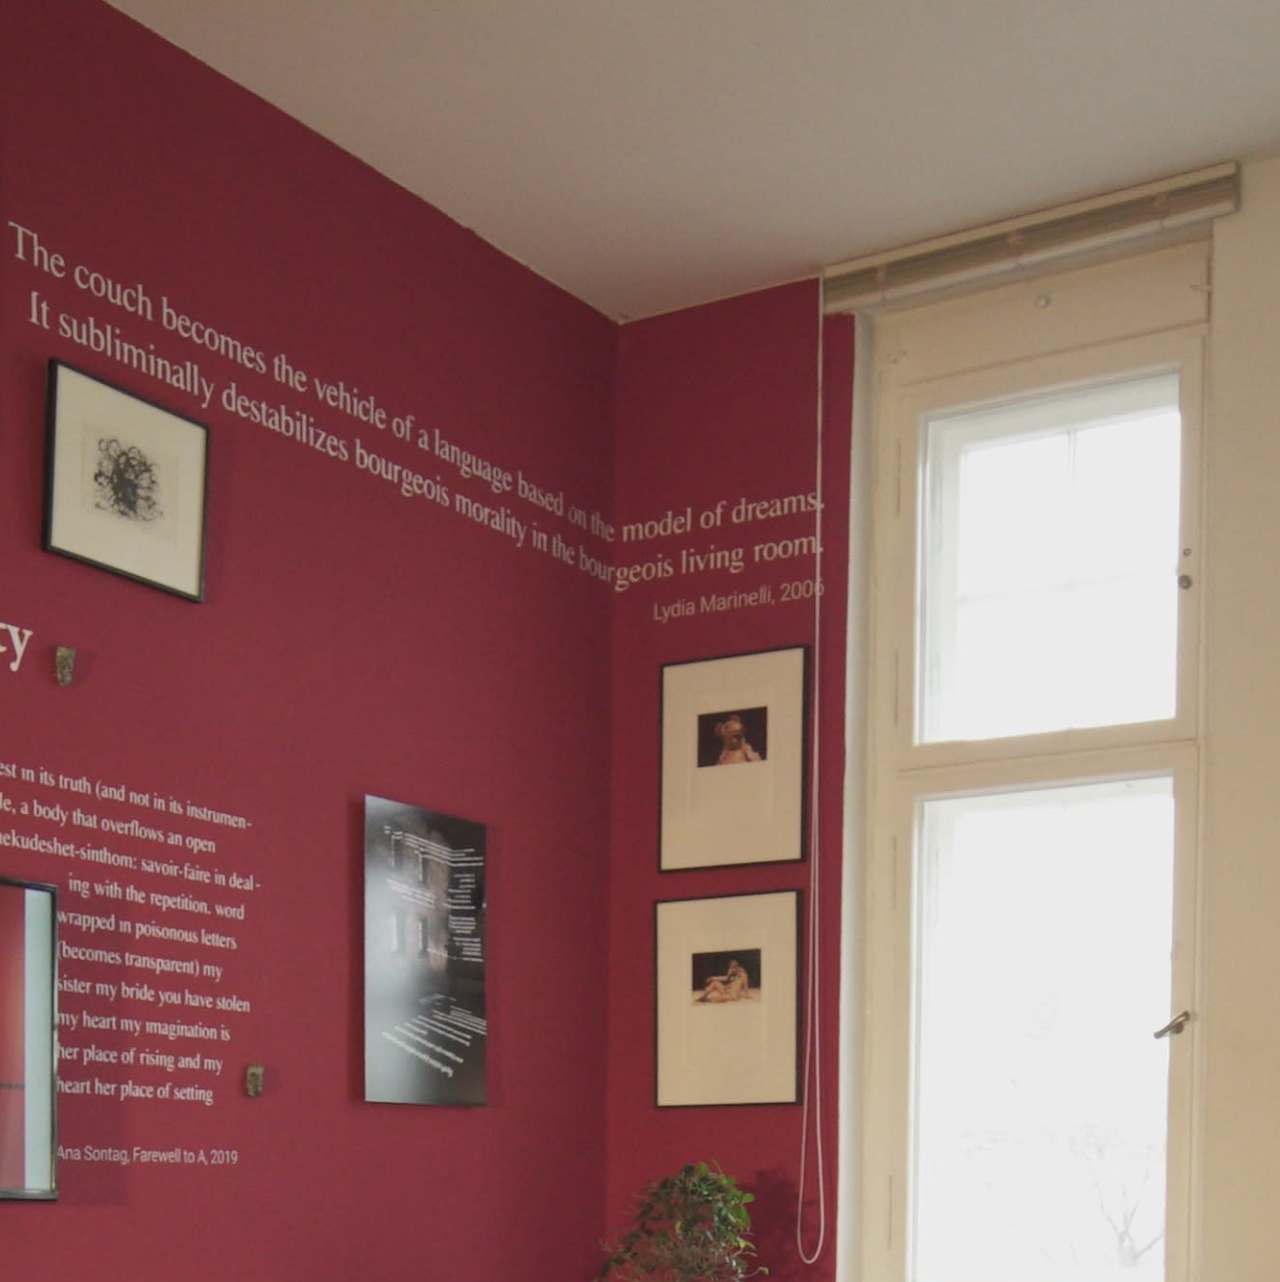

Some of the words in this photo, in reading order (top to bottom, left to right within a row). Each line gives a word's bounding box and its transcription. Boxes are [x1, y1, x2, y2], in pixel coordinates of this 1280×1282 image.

[7, 220, 66, 278] The
[74, 265, 154, 321] couch
[160, 296, 267, 374] becomes
[272, 353, 308, 392] the
[313, 377, 387, 430] vehicle
[391, 414, 416, 442] of
[417, 429, 430, 451] a
[433, 428, 513, 493] language
[517, 470, 564, 517] based
[568, 505, 587, 529] on
[590, 512, 615, 542] the
[622, 508, 692, 544] model
[700, 500, 727, 529] of
[28, 290, 50, 330] It
[58, 313, 215, 409] subliminally
[221, 381, 349, 461] destabilizes
[354, 438, 450, 507] bourgeois
[455, 493, 528, 548] morality
[532, 522, 548, 552] in
[552, 533, 575, 565] the
[579, 545, 674, 593] bourgeois
[681, 544, 744, 574] living
[653, 599, 696, 624] Lydia
[20, 767, 36, 783] in
[39, 766, 56, 787] its
[58, 774, 92, 795] truth
[95, 779, 126, 802] (and
[128, 791, 152, 808] not
[153, 792, 166, 812] in
[168, 795, 184, 815] its
[20, 801, 30, 816] a
[32, 798, 69, 827] body
[71, 808, 98, 829] that
[101, 819, 165, 844] overflows
[166, 832, 183, 847] an
[185, 836, 216, 854] open
[68, 872, 91, 899] ing
[93, 879, 123, 900] with
[125, 884, 146, 904] the
[214, 904, 245, 920] word
[140, 858, 212, 884] savoir-faire
[214, 868, 227, 887] in
[94, 1077, 119, 1096] her
[119, 1080, 155, 1101] place
[156, 1082, 173, 1099] of
[173, 1084, 214, 1106] setting
